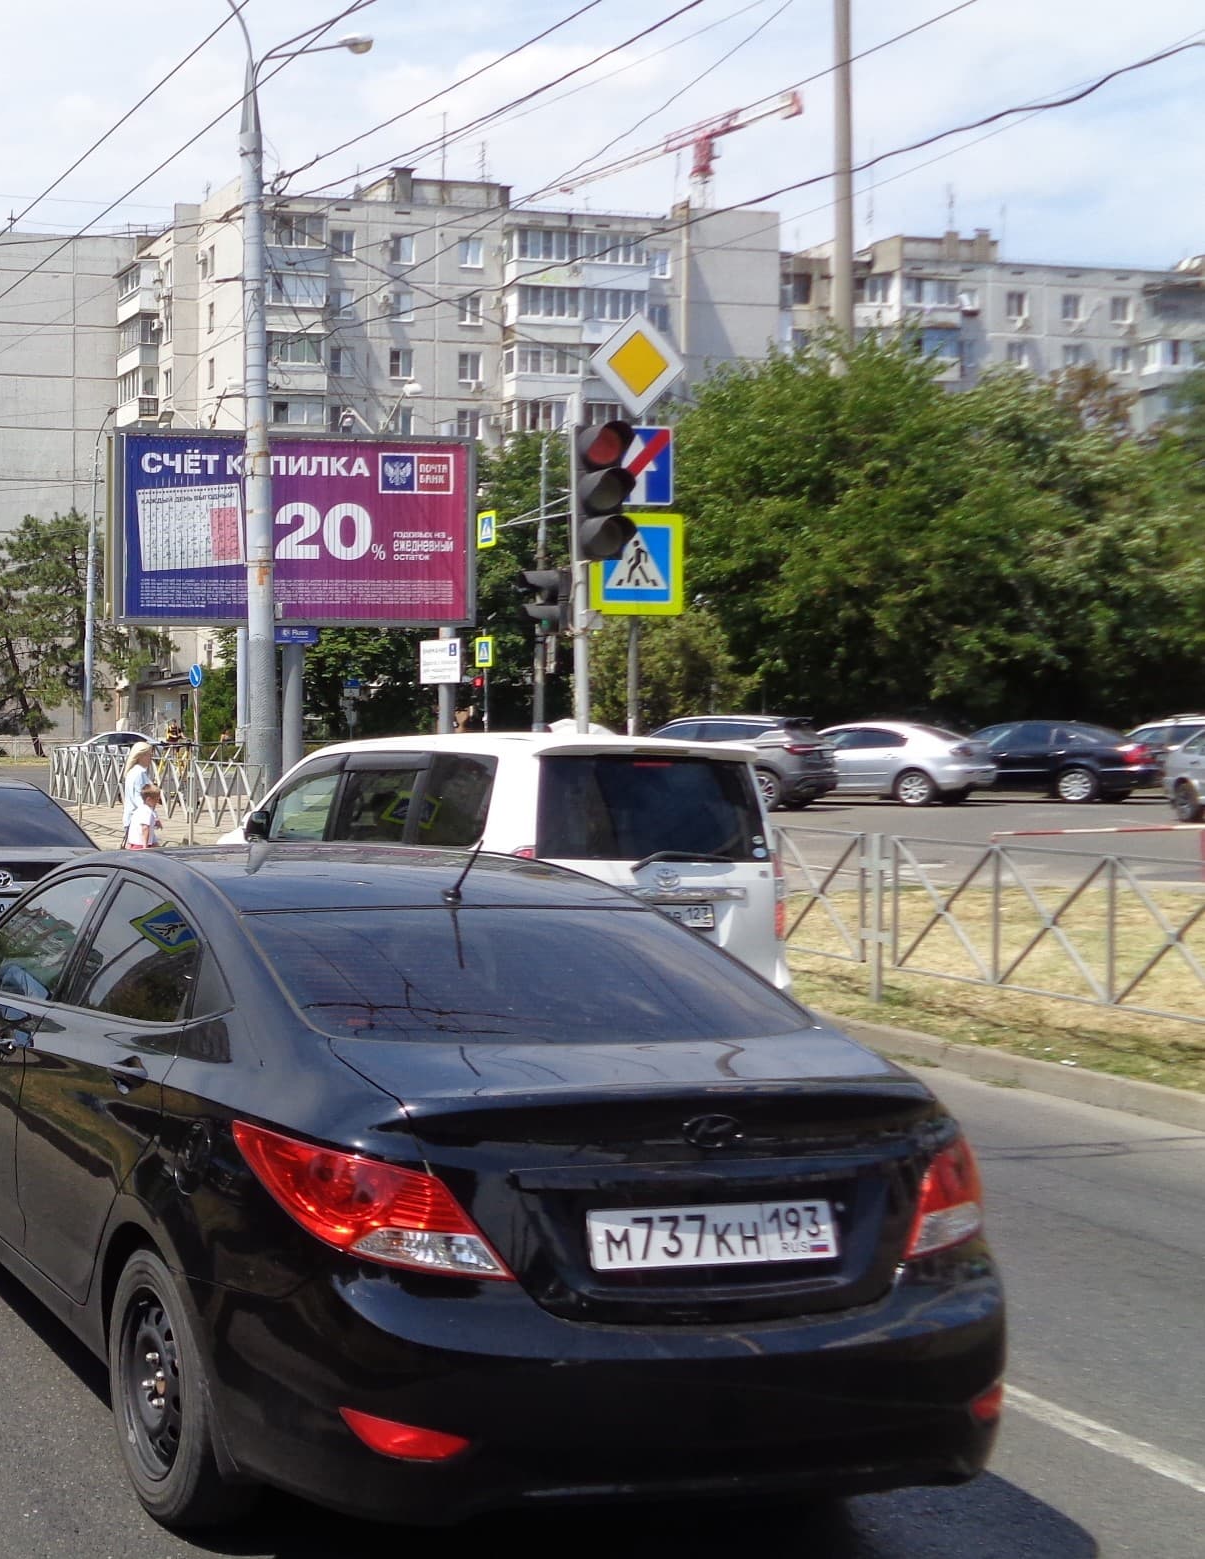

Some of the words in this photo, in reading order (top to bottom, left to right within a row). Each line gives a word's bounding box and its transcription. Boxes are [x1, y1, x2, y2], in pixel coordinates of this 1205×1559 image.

[141, 449, 220, 475] СЧЁТ
[226, 454, 371, 477] КПИЛКА
[419, 463, 448, 474] ПОЧТА
[419, 474, 445, 484] БАНК
[393, 536, 454, 552] ежедневный
[393, 553, 430, 561] остаток
[781, 1241, 809, 1252] RUS
